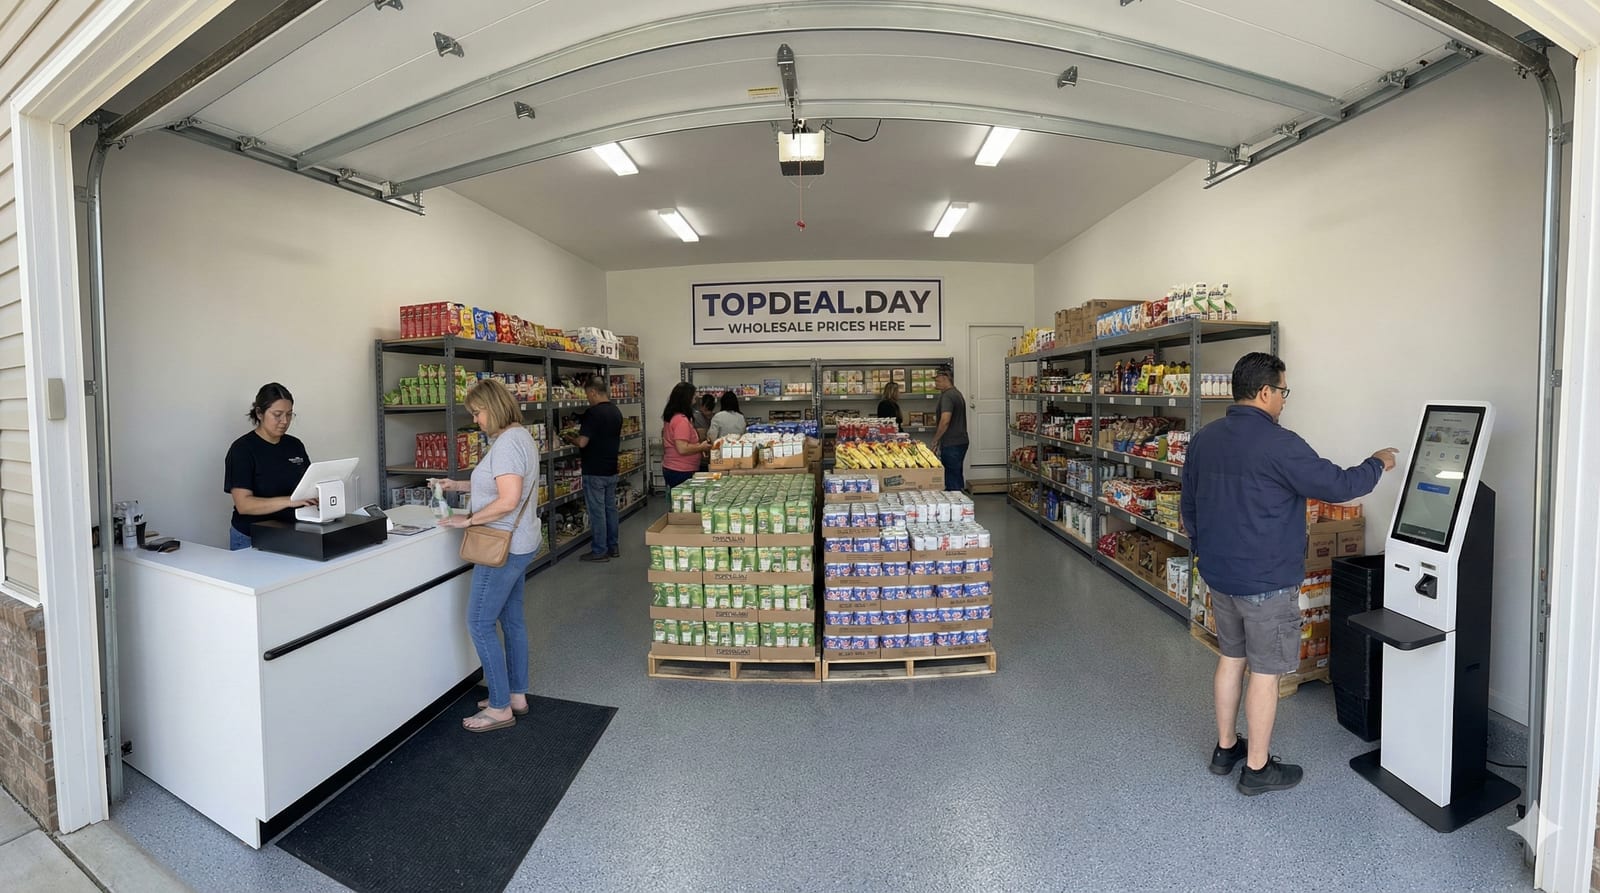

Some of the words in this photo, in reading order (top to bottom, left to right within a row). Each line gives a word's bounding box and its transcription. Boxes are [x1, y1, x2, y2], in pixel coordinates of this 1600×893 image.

[702, 290, 931, 317] TOPDEAL.DAY
[728, 321, 813, 334] WHOLESALE
[817, 320, 865, 332] PRICES
[869, 320, 905, 331] HERE
